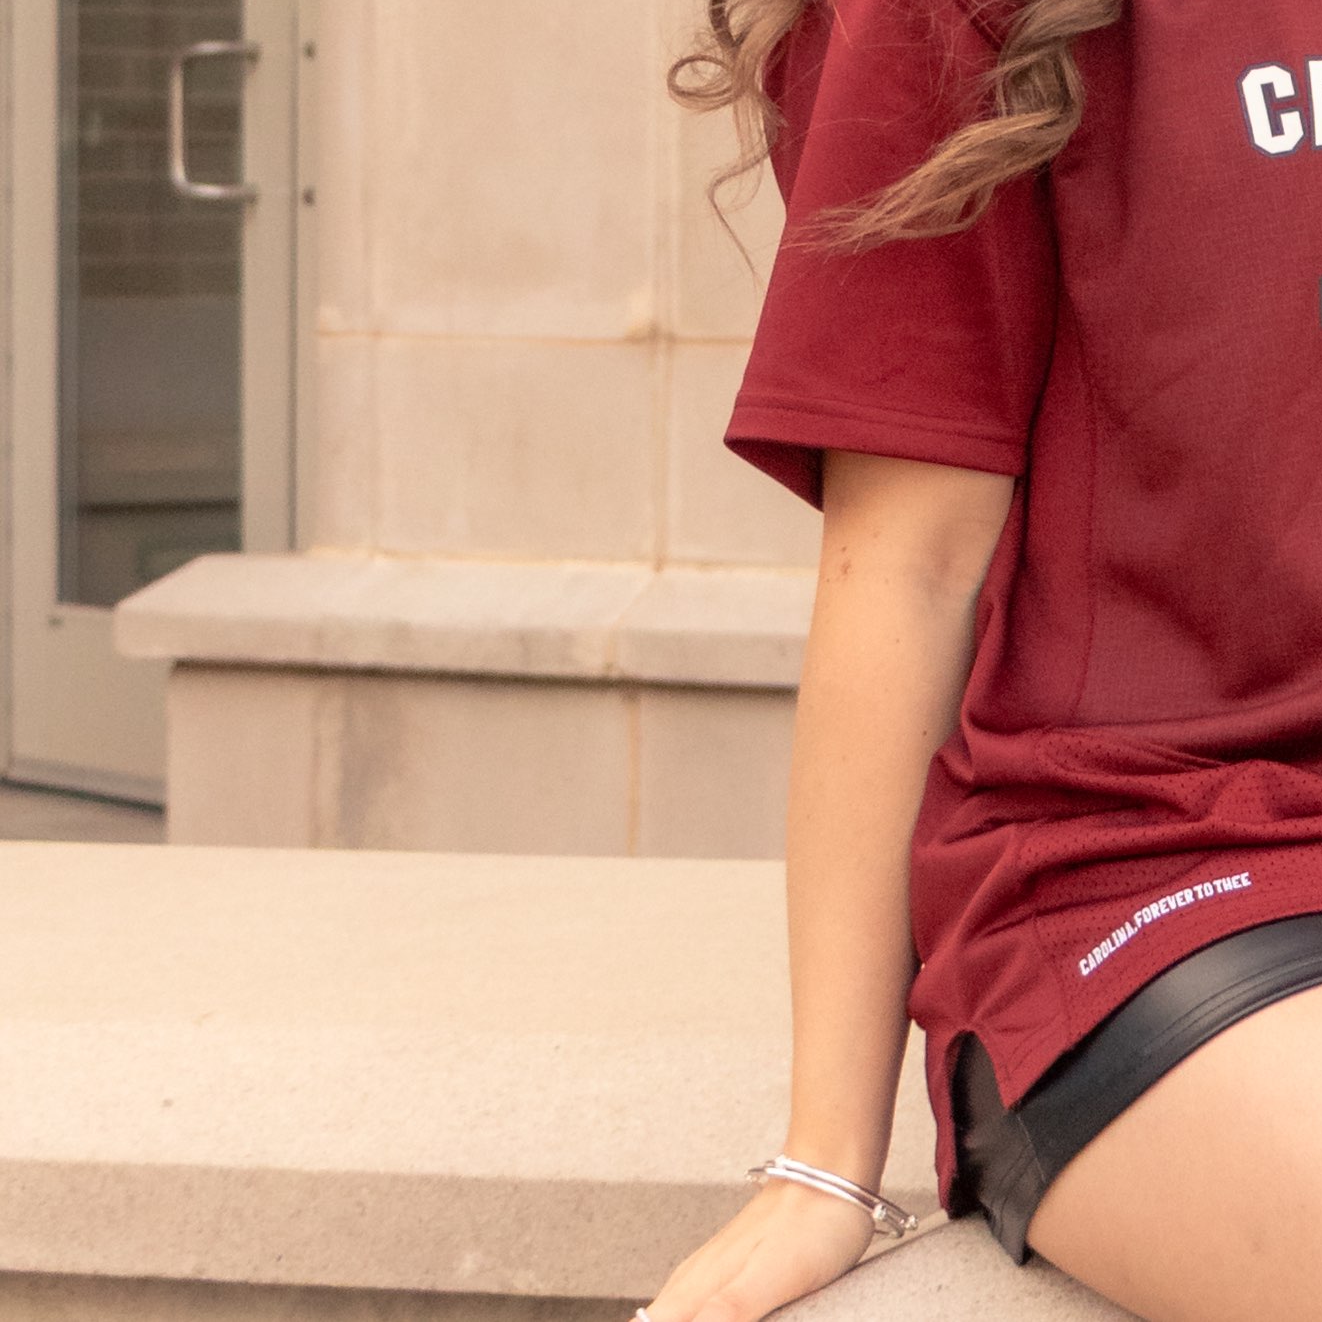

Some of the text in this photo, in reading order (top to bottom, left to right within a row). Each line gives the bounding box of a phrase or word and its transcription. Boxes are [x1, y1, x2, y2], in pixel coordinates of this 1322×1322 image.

[1133, 888, 1195, 928] FOREVER
[1193, 882, 1214, 900] TO
[1212, 871, 1252, 893] THEE
